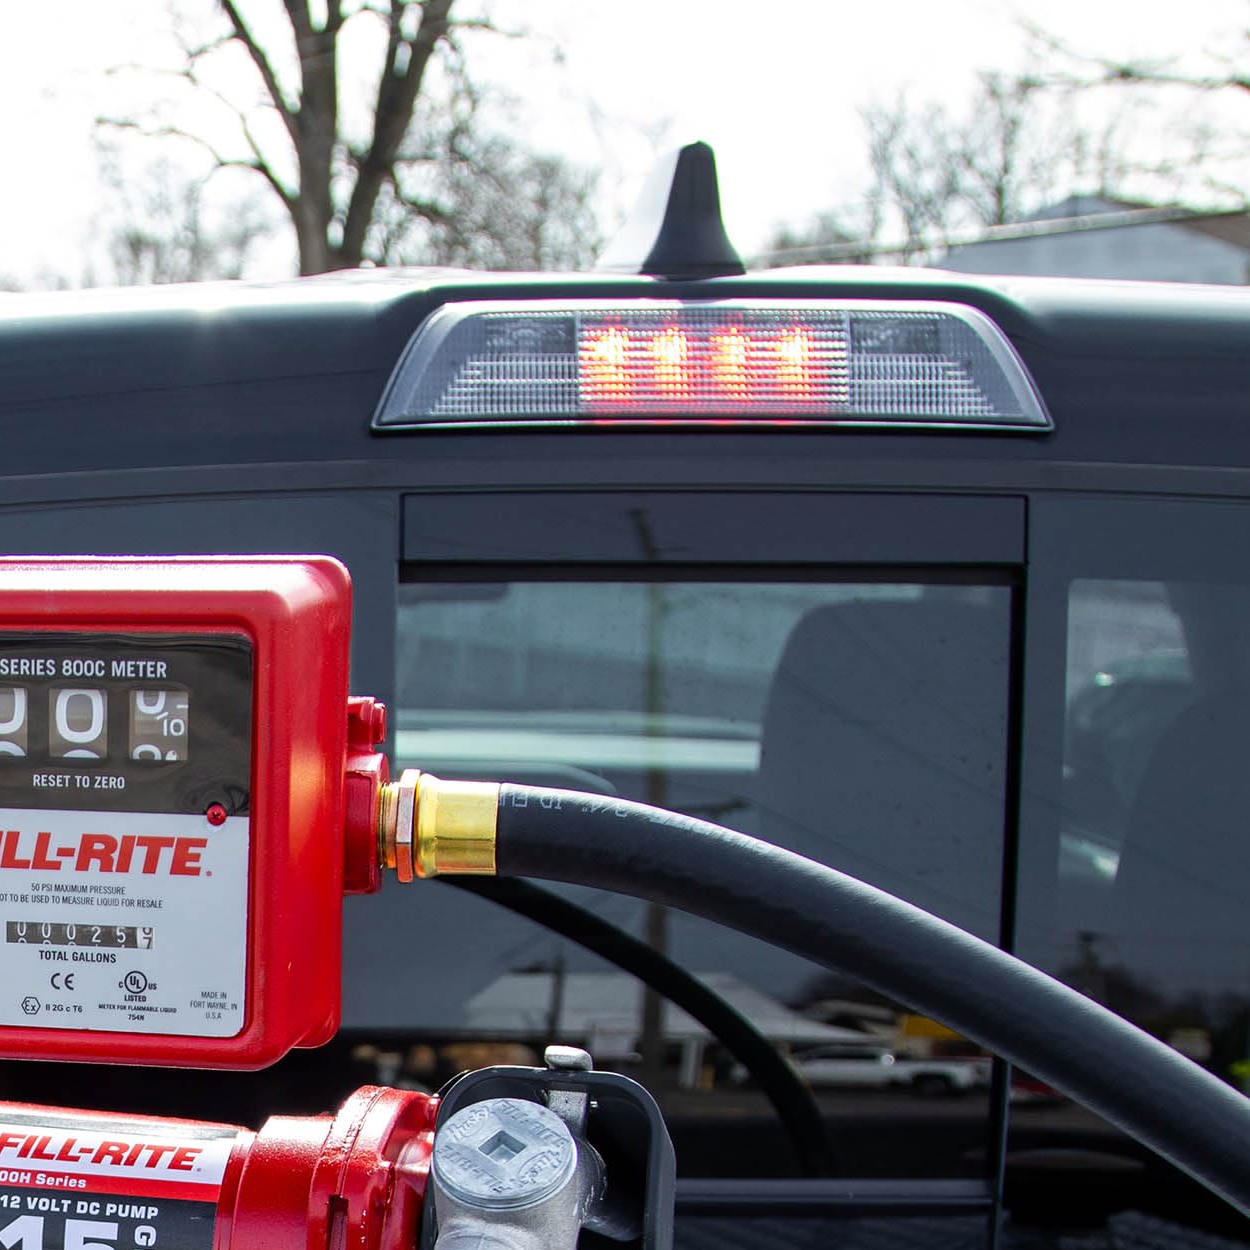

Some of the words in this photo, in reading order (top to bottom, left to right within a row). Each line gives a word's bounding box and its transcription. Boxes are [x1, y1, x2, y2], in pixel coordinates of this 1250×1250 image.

[0, 658, 56, 676] SERIES
[62, 659, 106, 677] 800C
[111, 660, 167, 678] METER
[32, 774, 71, 788] RESET
[74, 775, 91, 788] TO
[94, 776, 126, 789] ZERO
[31, 883, 40, 892] 50
[41, 883, 53, 893] PSI
[54, 884, 88, 894] MAXIMUM
[89, 885, 126, 896] PRESSURE
[10, 894, 19, 903] TO
[20, 895, 29, 903] BE
[31, 895, 50, 904] USED
[51, 895, 61, 904] TO
[61, 896, 94, 905] MEASURE
[96, 898, 120, 907] LIQUID
[121, 899, 135, 908] FOR
[136, 899, 163, 909] RESALE
[39, 950, 68, 961] TOTAL
[72, 952, 116, 963] GALLONS
[50, 972, 74, 991] CE
[201, 991, 219, 999] MADE
[220, 992, 227, 1000] IN
[52, 1004, 64, 1012] 2G
[72, 1005, 83, 1013] T6
[128, 1005, 158, 1013] FLAMMABLE
[190, 1000, 205, 1009] FORT
[231, 1003, 238, 1011] IN
[35, 1174, 87, 1188] Series
[0, 1194, 20, 1209] 12
[27, 1196, 71, 1213] VOLT
[76, 1201, 100, 1216] DC
[106, 1203, 159, 1220] PUMP
